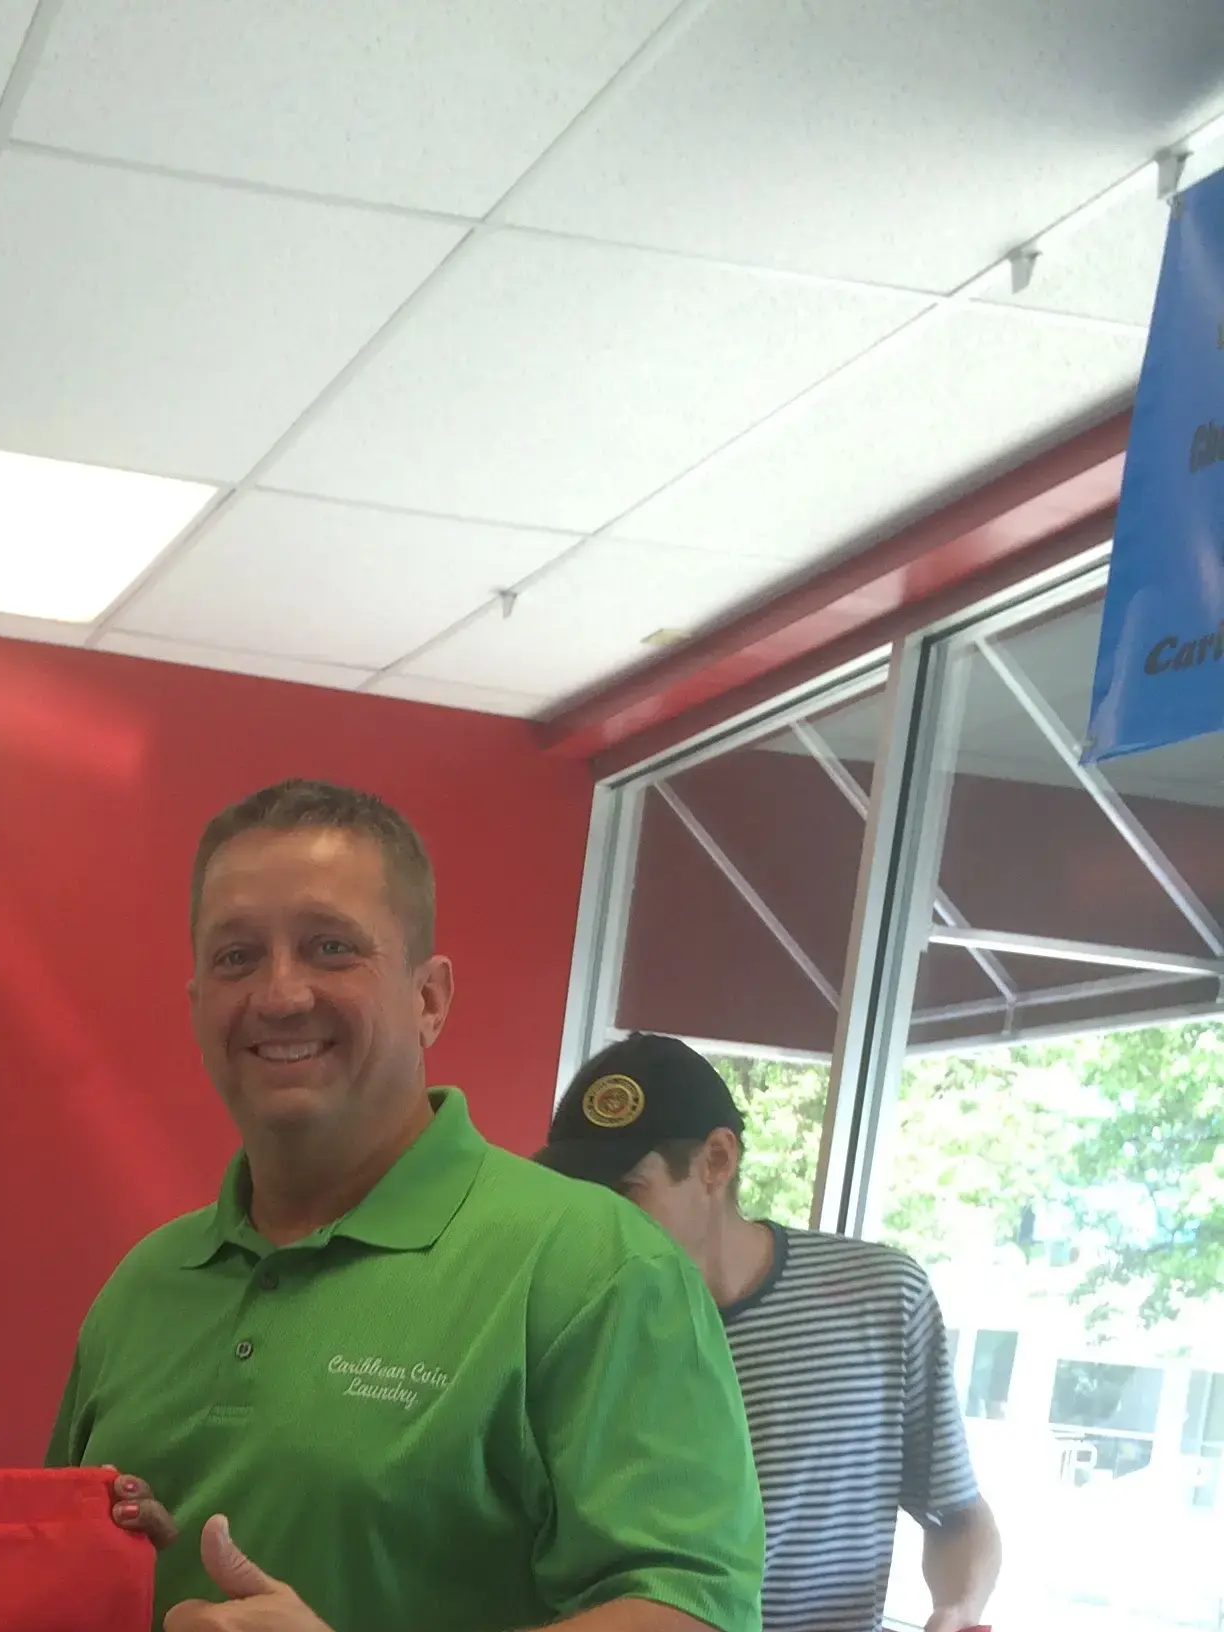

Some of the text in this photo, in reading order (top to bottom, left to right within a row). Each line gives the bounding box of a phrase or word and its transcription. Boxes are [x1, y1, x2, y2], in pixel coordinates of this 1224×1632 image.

[328, 1354, 448, 1387] Caribbean Coin
[342, 1376, 418, 1410] Laundry
